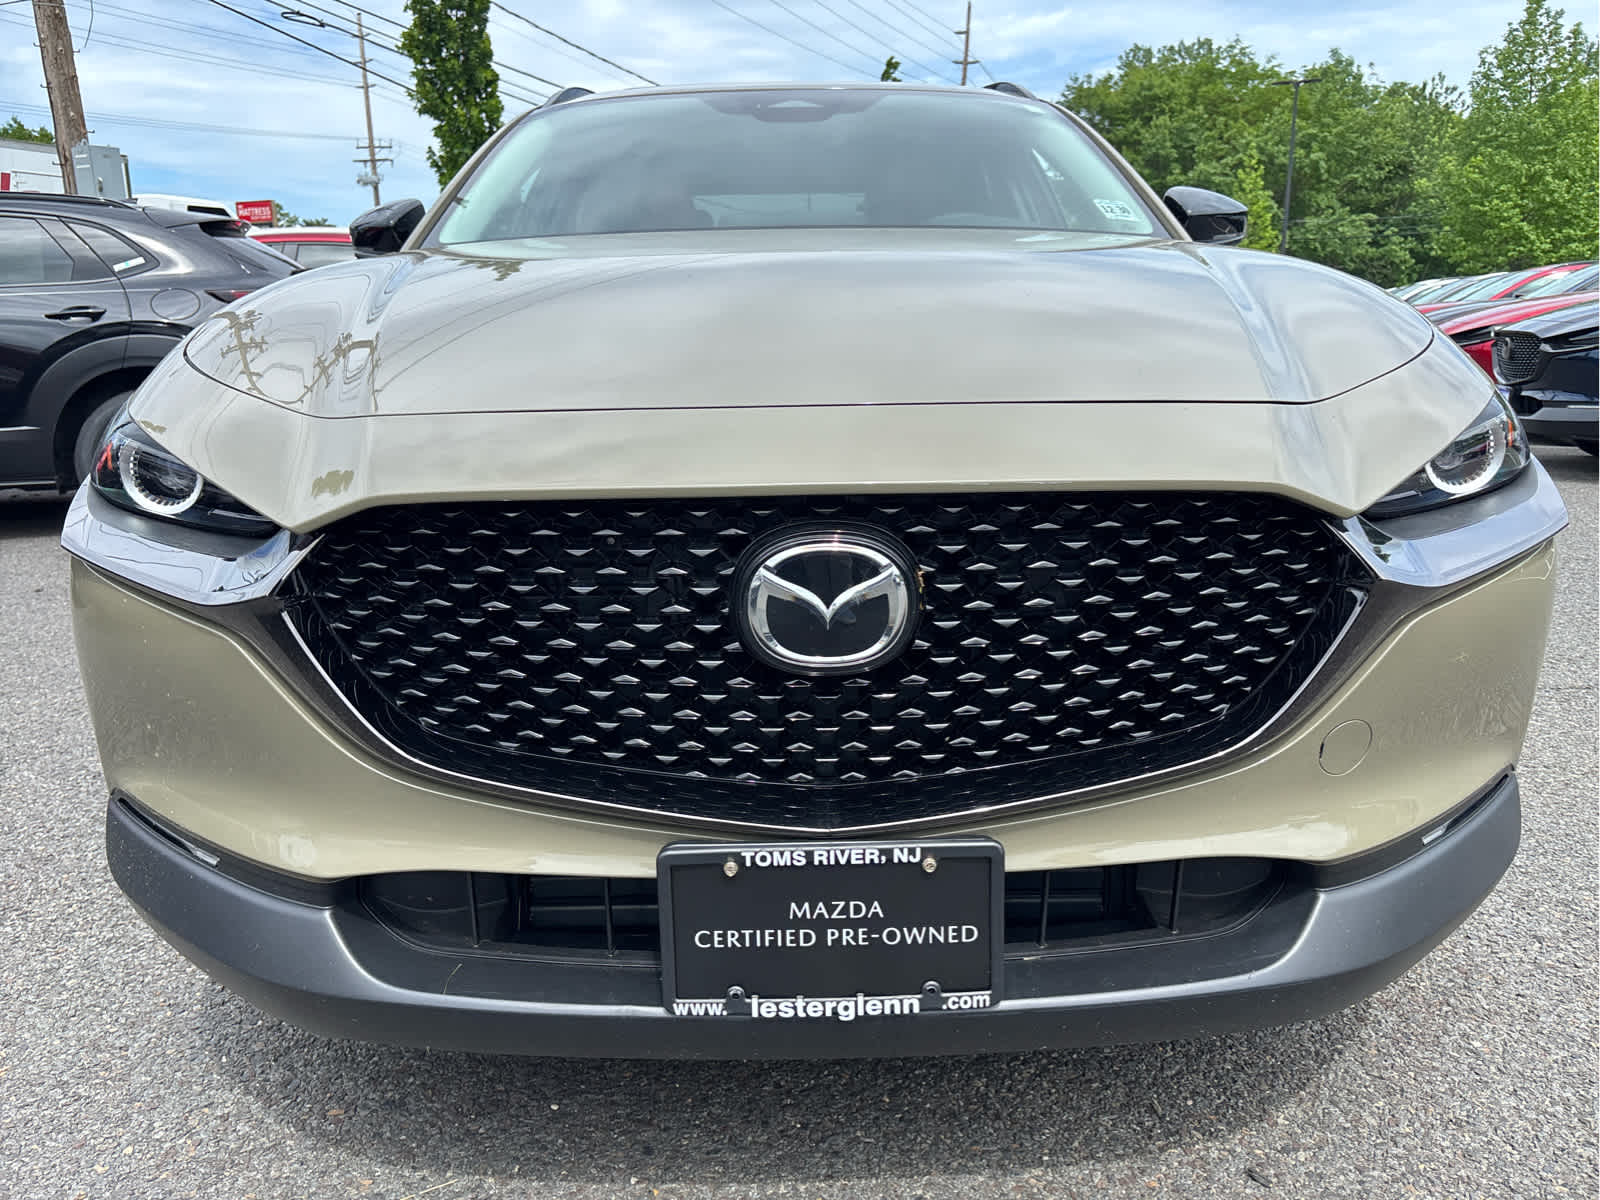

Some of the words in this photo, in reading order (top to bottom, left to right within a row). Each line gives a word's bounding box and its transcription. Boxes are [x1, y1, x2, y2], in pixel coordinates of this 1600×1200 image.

[741, 850, 807, 867] TOMS
[813, 848, 886, 865] RIVER,
[893, 847, 921, 863] NJ
[789, 901, 884, 919] MAZDA
[694, 929, 816, 948] CERTIFIED
[827, 925, 979, 946] PRE-OWNED
